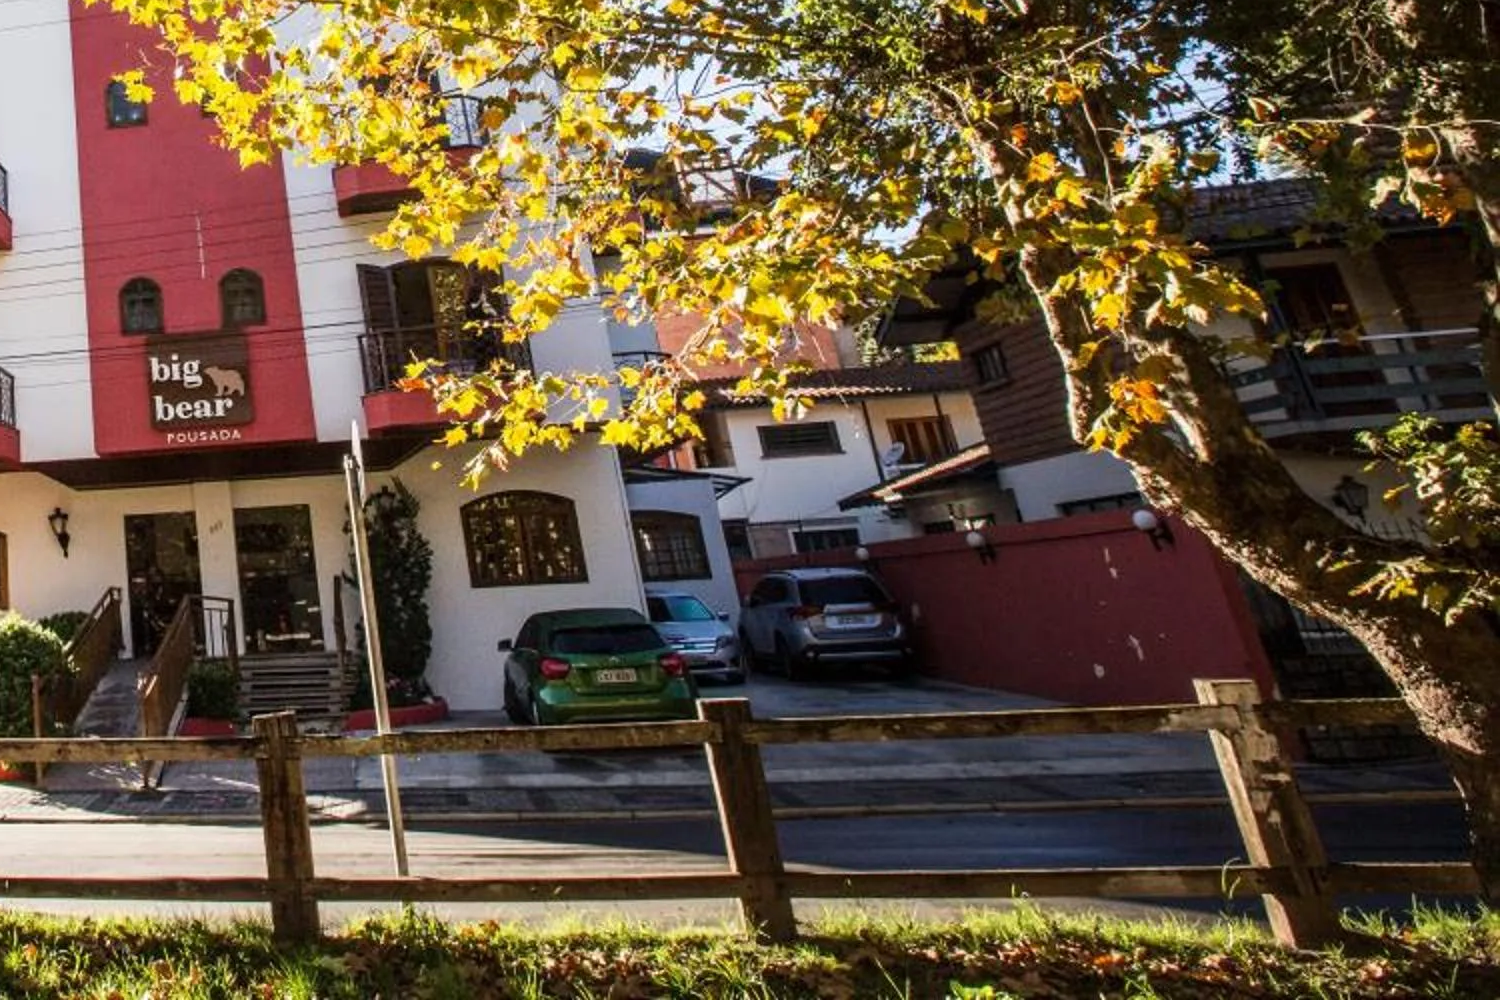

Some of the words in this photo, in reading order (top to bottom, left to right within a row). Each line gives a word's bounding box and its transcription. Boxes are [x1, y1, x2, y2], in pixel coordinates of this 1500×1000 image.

[150, 354, 202, 388] big
[154, 395, 233, 422] bear
[167, 429, 242, 444] POUSADA
